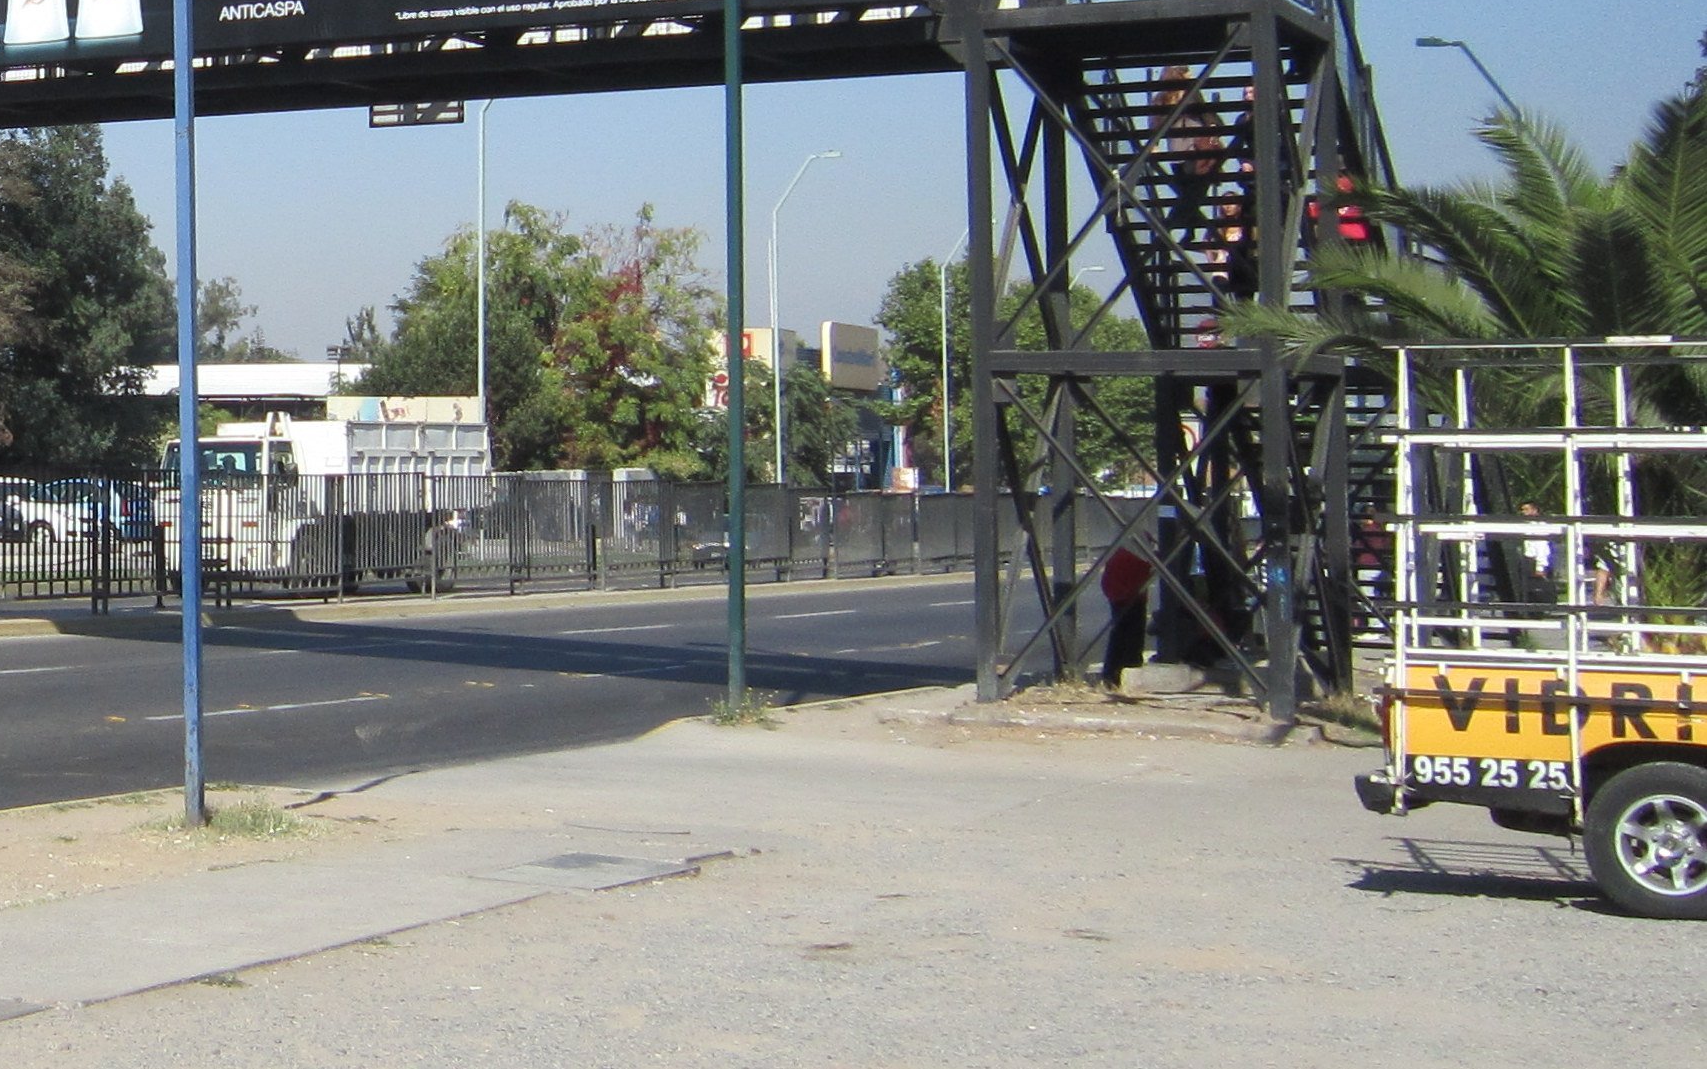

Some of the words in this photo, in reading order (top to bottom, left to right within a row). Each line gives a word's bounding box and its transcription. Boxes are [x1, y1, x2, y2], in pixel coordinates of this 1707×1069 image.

[219, 0, 305, 22] ANTICASPA
[418, 10, 429, 19] de
[454, 6, 480, 16] visible
[480, 6, 496, 14] con
[497, 4, 505, 13] el
[506, 4, 521, 12] uso
[1414, 756, 1471, 786] 955
[1480, 759, 1519, 787] 25
[1527, 761, 1567, 790] 25
